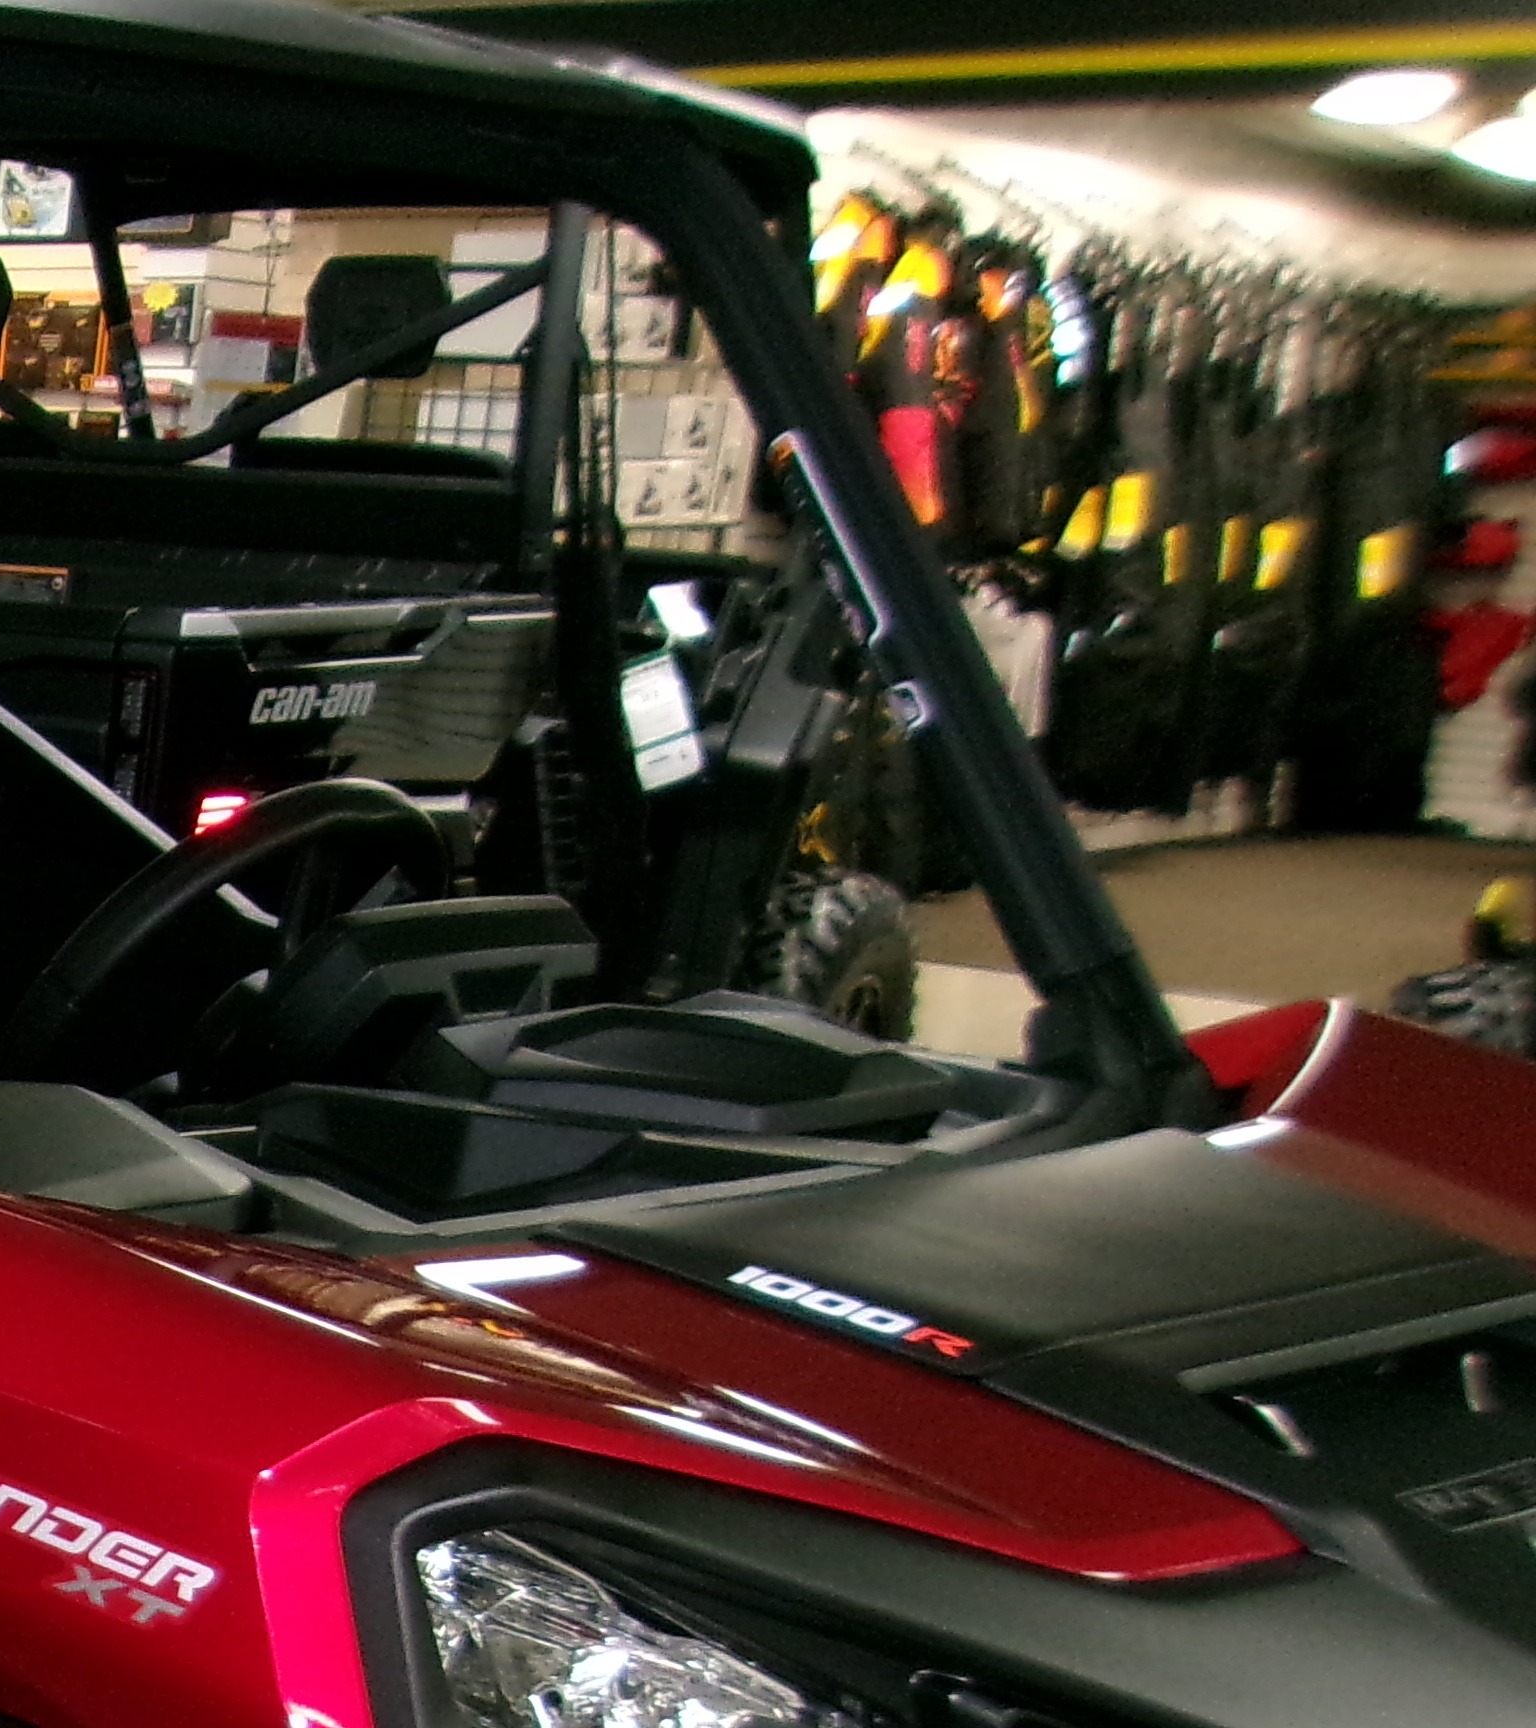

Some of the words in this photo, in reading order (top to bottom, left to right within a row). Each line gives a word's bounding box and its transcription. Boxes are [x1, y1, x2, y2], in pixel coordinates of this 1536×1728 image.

[249, 681, 377, 724] can-am
[726, 1265, 975, 1358] 1000R
[51, 1565, 186, 1625] XT
